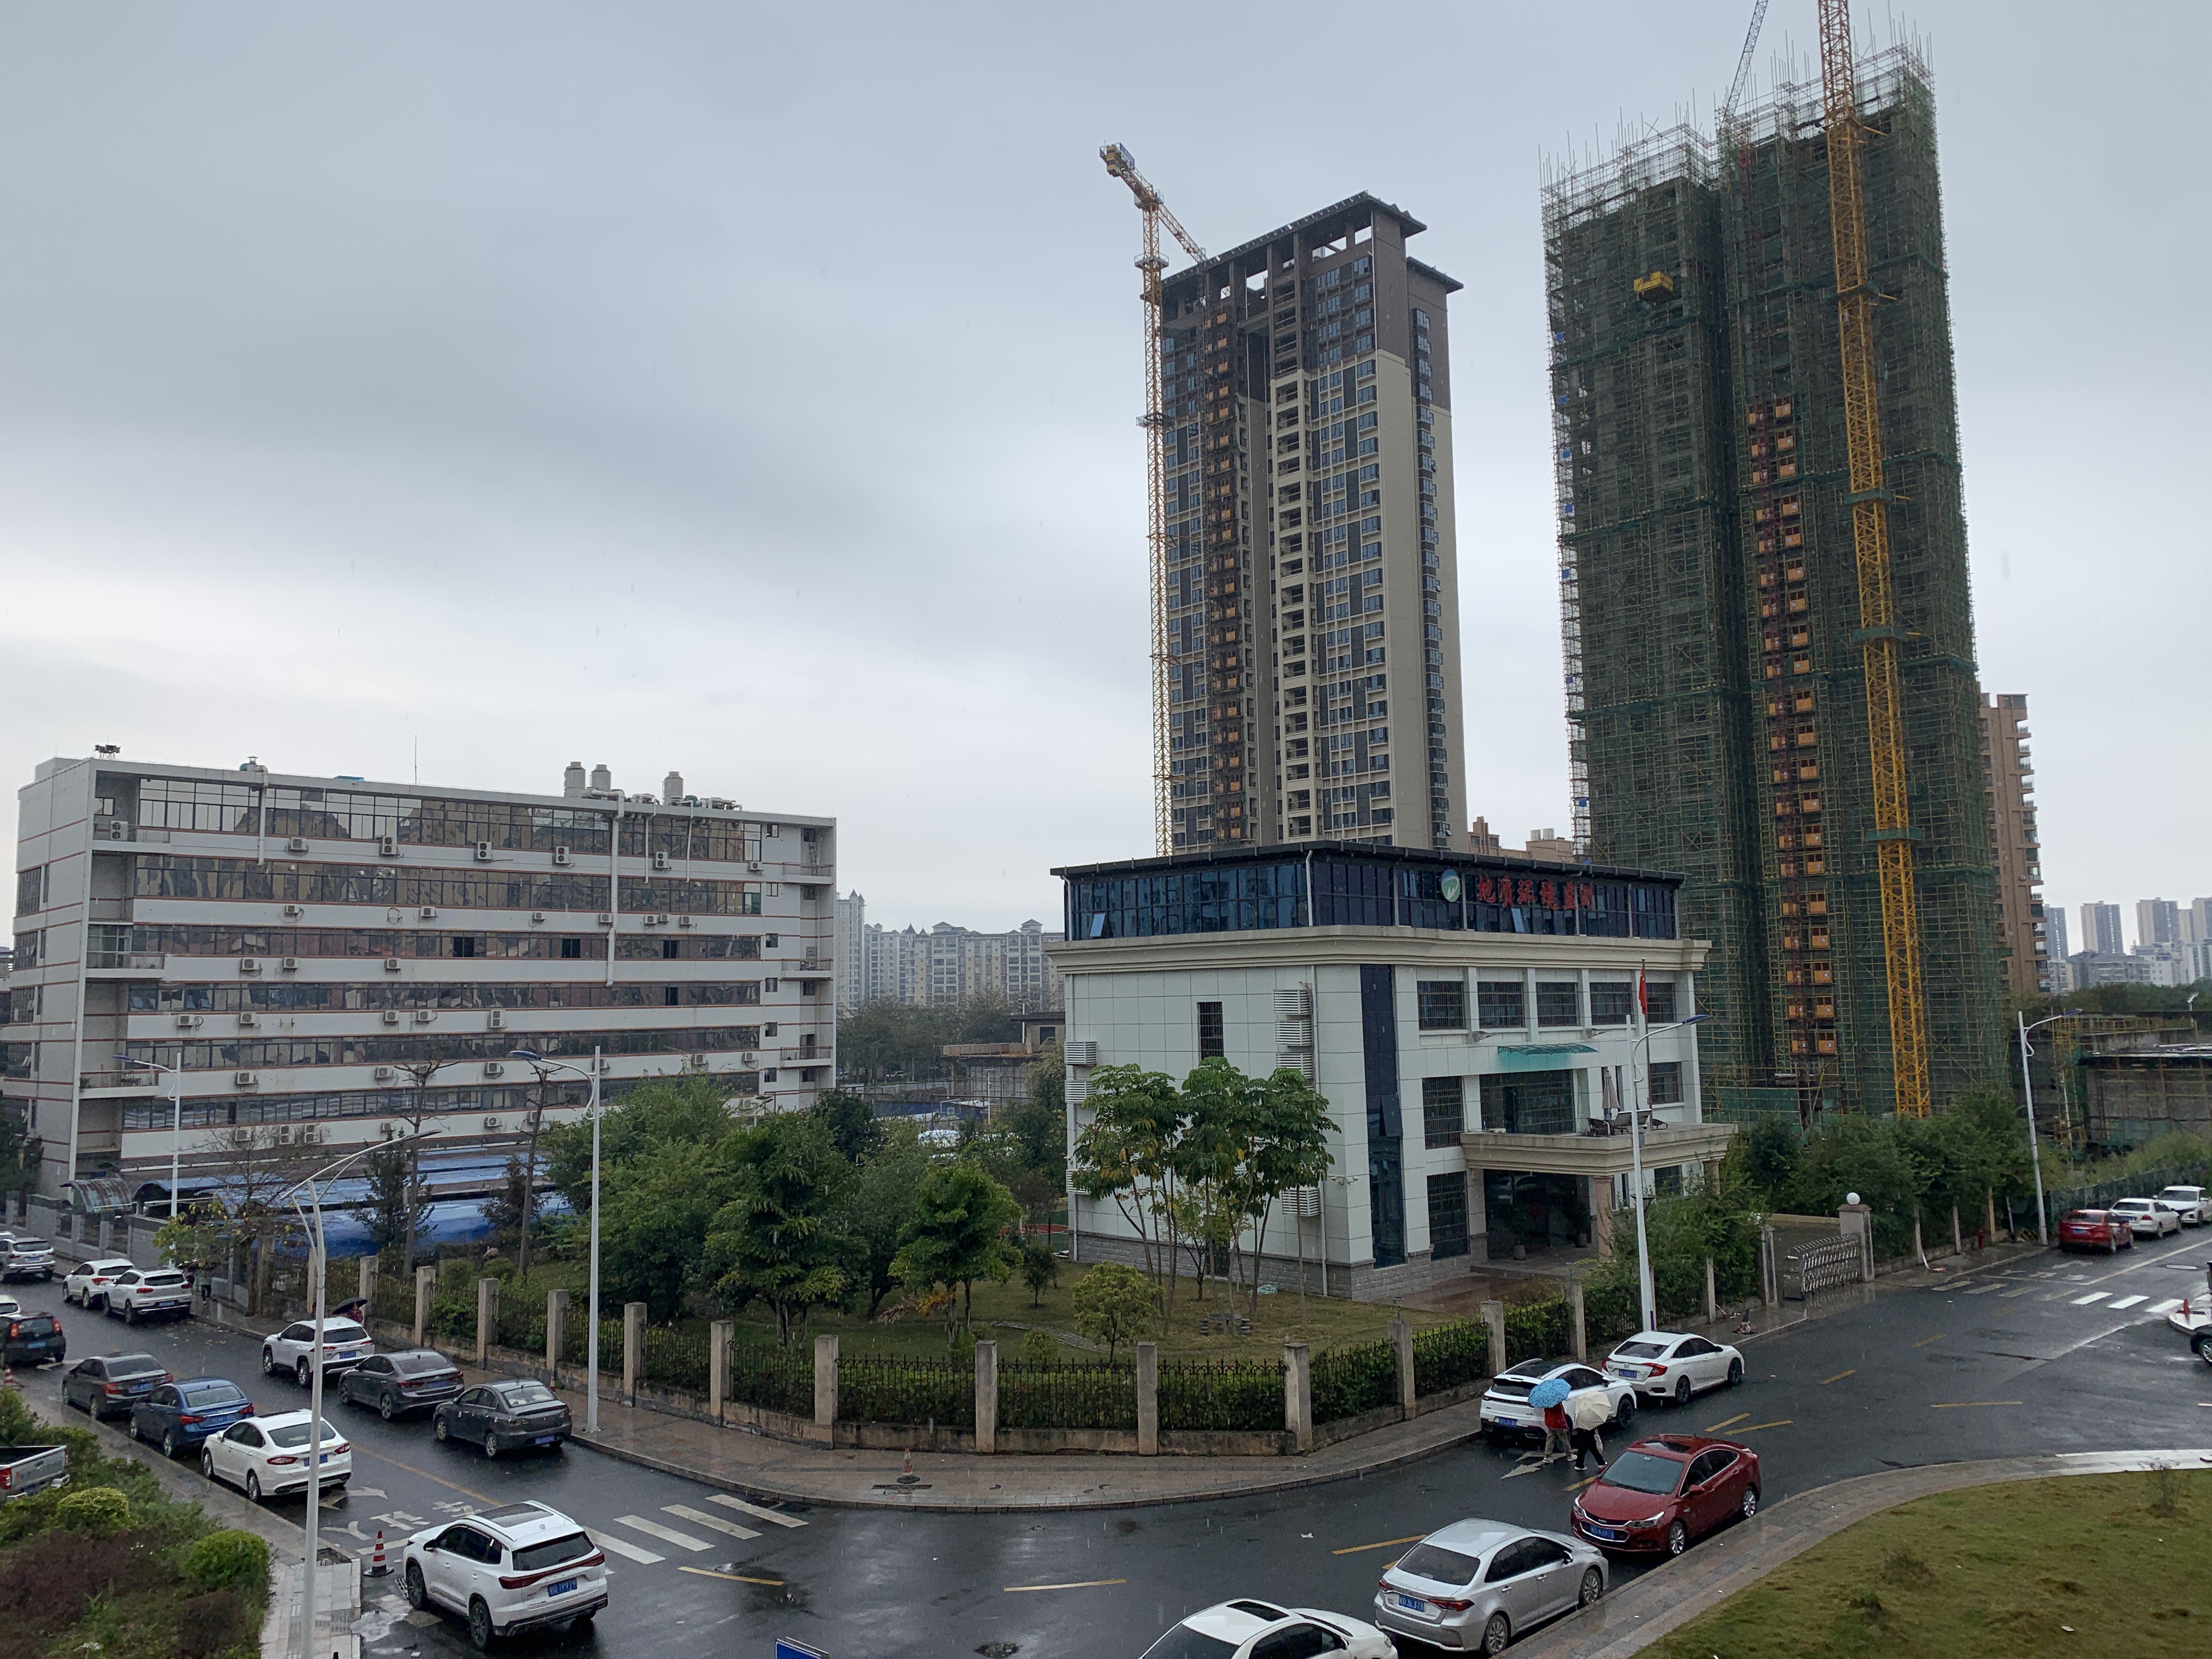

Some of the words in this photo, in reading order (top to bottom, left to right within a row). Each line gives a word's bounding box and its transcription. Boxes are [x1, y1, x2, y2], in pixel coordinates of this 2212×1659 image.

[1477, 876, 1594, 910] 地质环境监测
